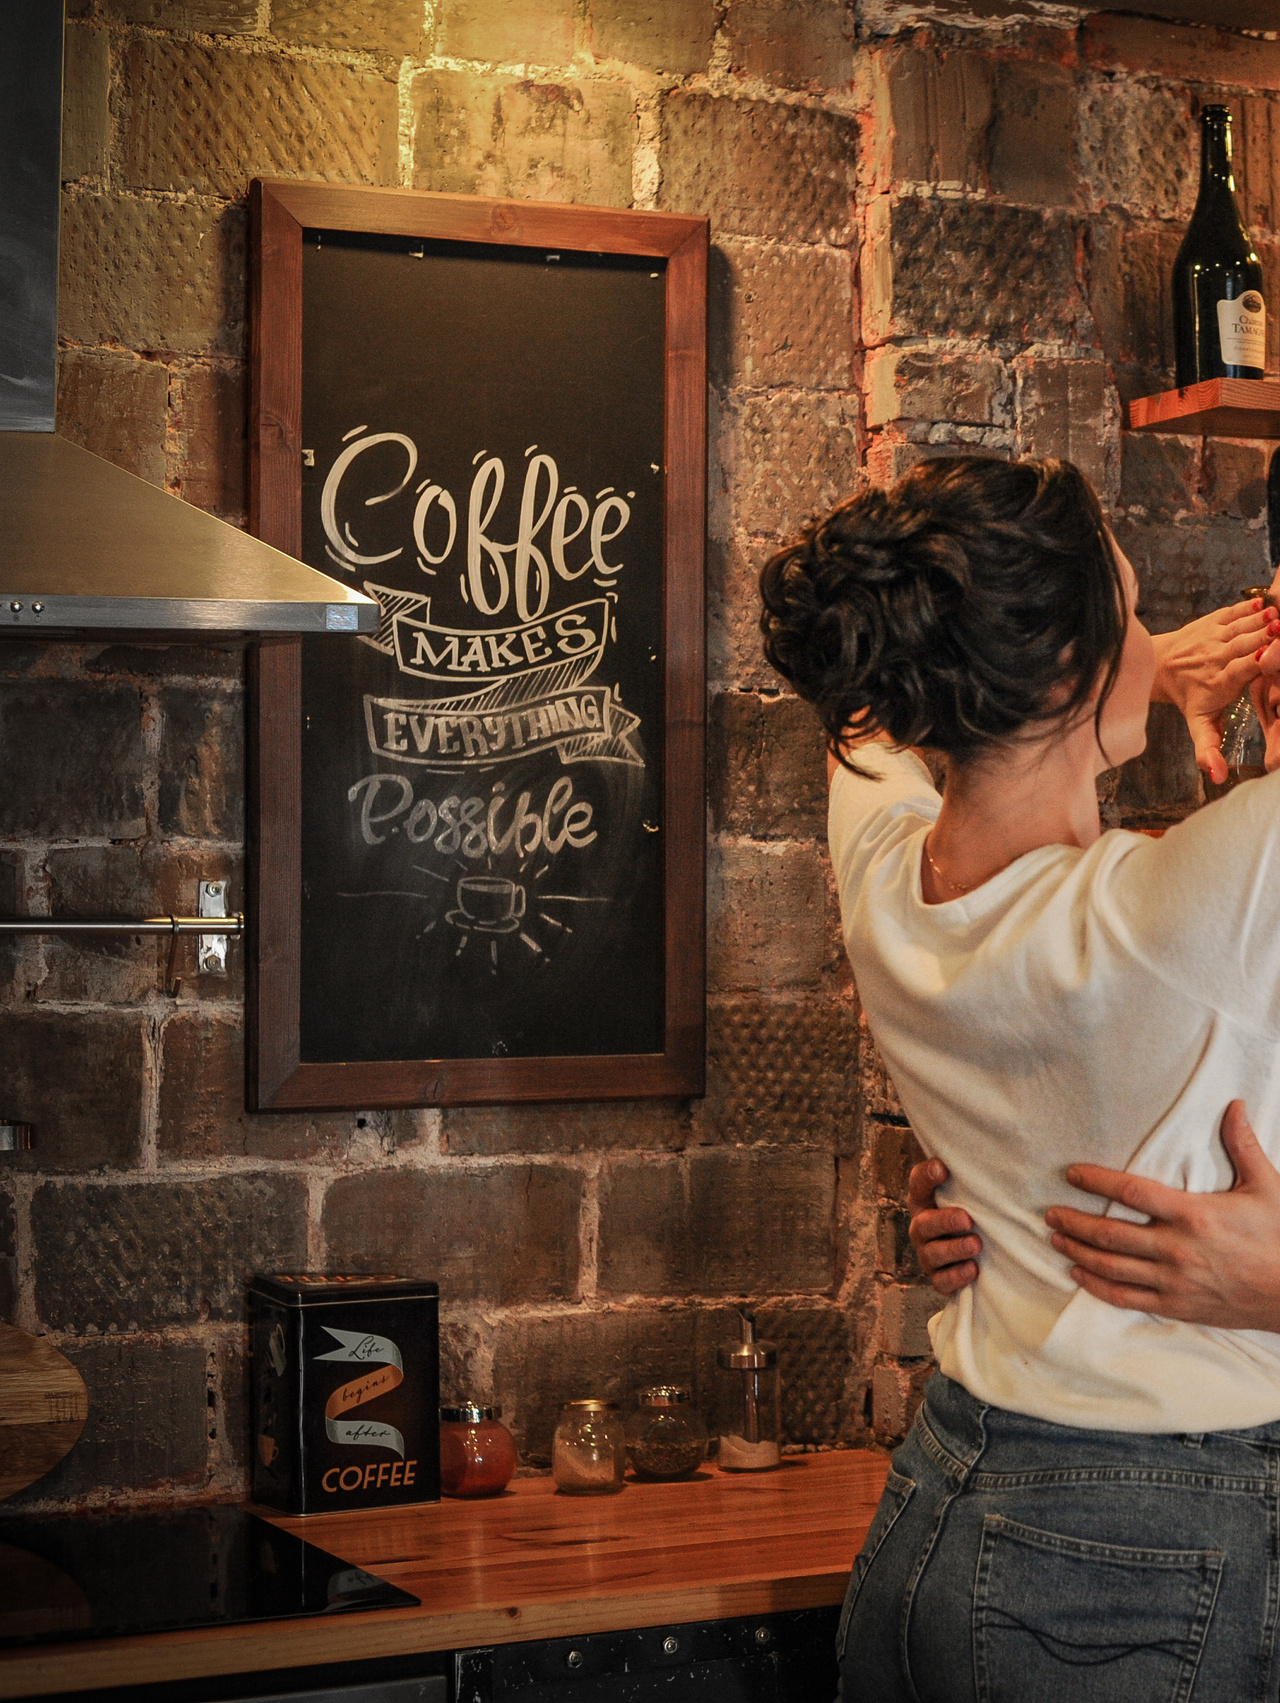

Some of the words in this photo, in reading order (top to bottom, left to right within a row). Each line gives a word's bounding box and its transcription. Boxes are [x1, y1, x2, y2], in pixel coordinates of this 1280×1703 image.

[321, 431, 631, 622] Coffee
[410, 613, 597, 673] MAKES
[383, 694, 602, 758] EVERYTHING
[348, 775, 598, 858] Possible
[348, 1335, 384, 1360] Life
[342, 1375, 391, 1403] begins
[345, 1424, 391, 1441] after
[322, 1460, 417, 1493] COFFEE
